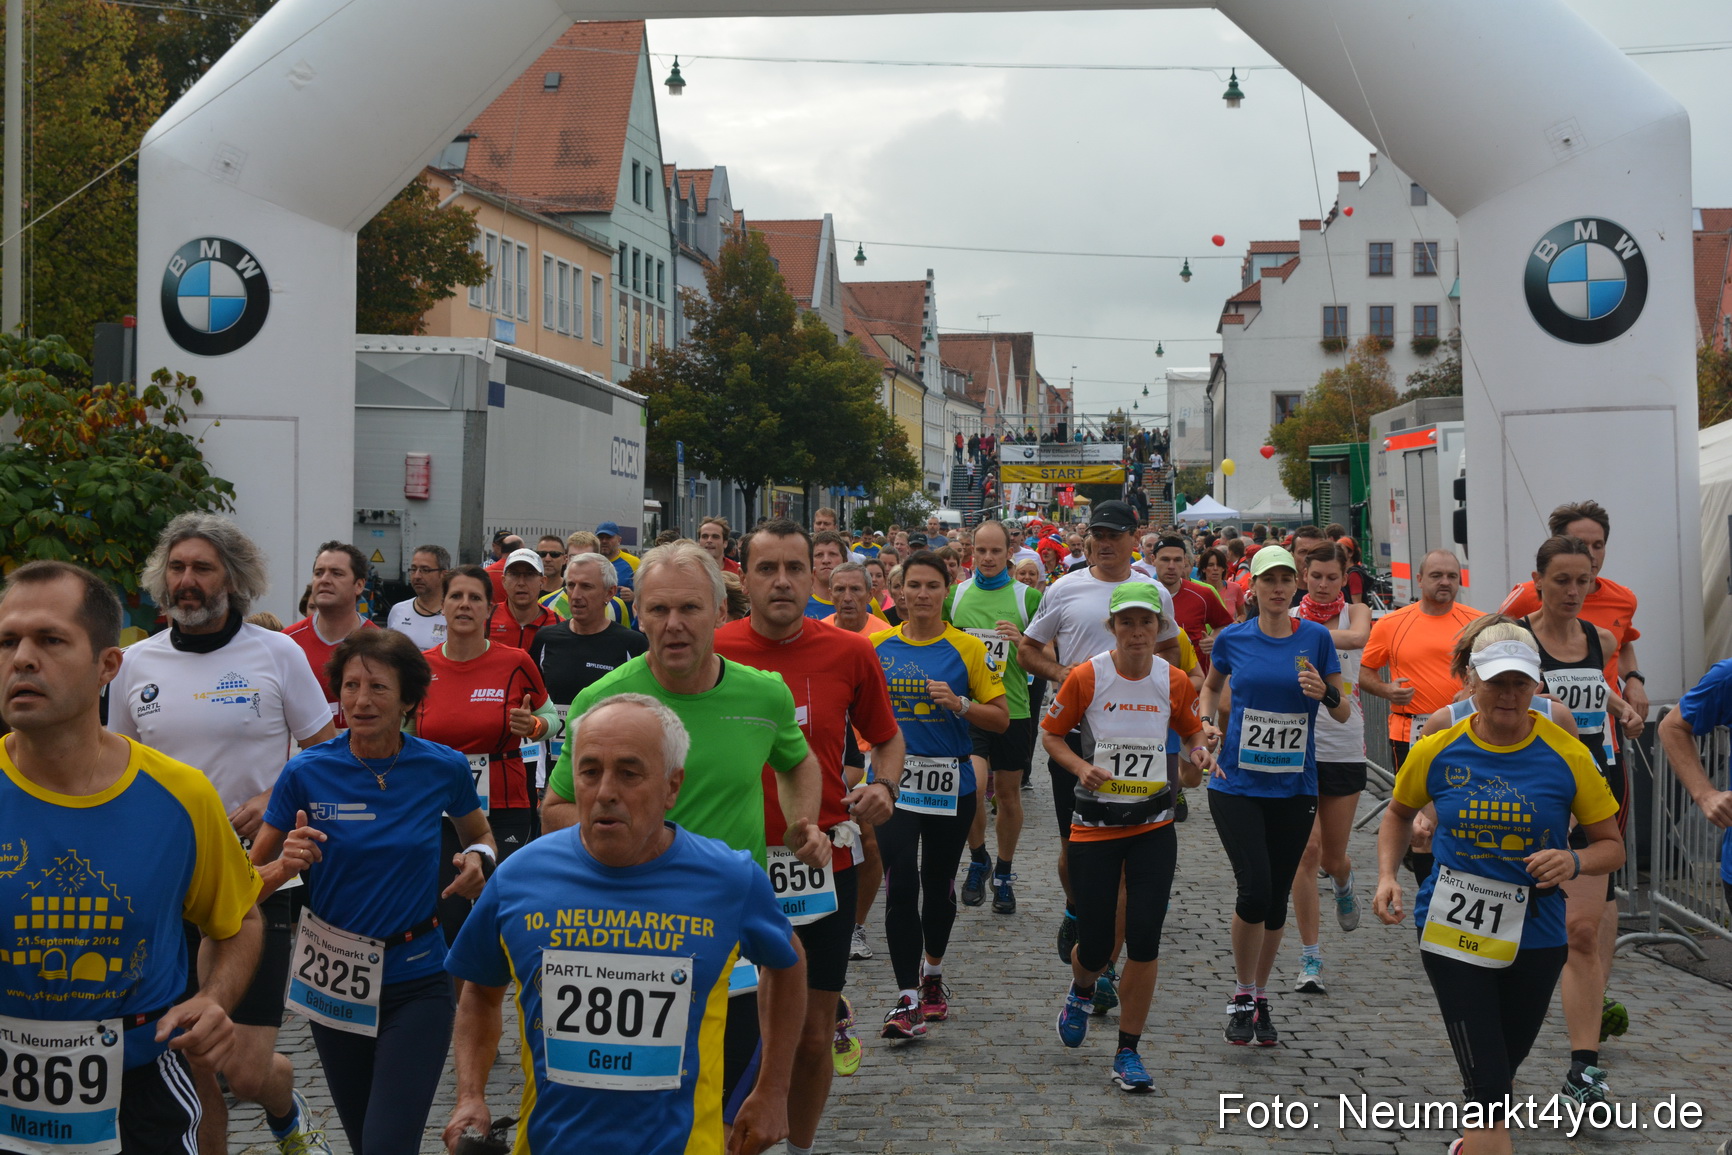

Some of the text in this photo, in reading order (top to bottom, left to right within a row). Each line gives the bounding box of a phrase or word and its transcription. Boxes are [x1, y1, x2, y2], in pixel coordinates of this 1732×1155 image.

[1534, 220, 1639, 264] BMW
[168, 239, 261, 279] BMW
[611, 437, 639, 479] BOCK
[1041, 469, 1084, 479] START
[1547, 675, 1570, 683] PARTL
[471, 689, 504, 698] JURA
[1557, 684, 1606, 710] 2019
[137, 702, 161, 714] PARTL
[1119, 704, 1161, 713] KLEBL
[1245, 714, 1267, 723] PARTL
[1577, 716, 1589, 726] tra
[1247, 725, 1302, 749] 2412
[1110, 753, 1154, 777] 127
[1254, 752, 1291, 764] Krisztina
[901, 769, 954, 793] 2108
[1111, 782, 1148, 794] Sylvana
[901, 793, 949, 808] Anna-Maria
[1459, 822, 1511, 831] 21.September
[2, 842, 12, 850] 15
[1440, 875, 1512, 901] PARTL Neumarkt
[524, 909, 714, 937] 10. NEUMARKTER
[1446, 892, 1504, 934] 241
[16, 936, 120, 948] 21.September 2014
[301, 925, 365, 960] PARTL Neumarkt
[550, 928, 684, 951] STADTLAUF
[1458, 935, 1478, 952] Eva
[298, 944, 371, 1000] 2325
[545, 963, 665, 983] PARTL Neumarkt
[306, 990, 353, 1019] Gabriele
[556, 984, 676, 1038] 2807
[0, 1028, 95, 1048] TL Neumarkt
[588, 1049, 632, 1071] Gerd
[11, 1113, 72, 1139] Martin
